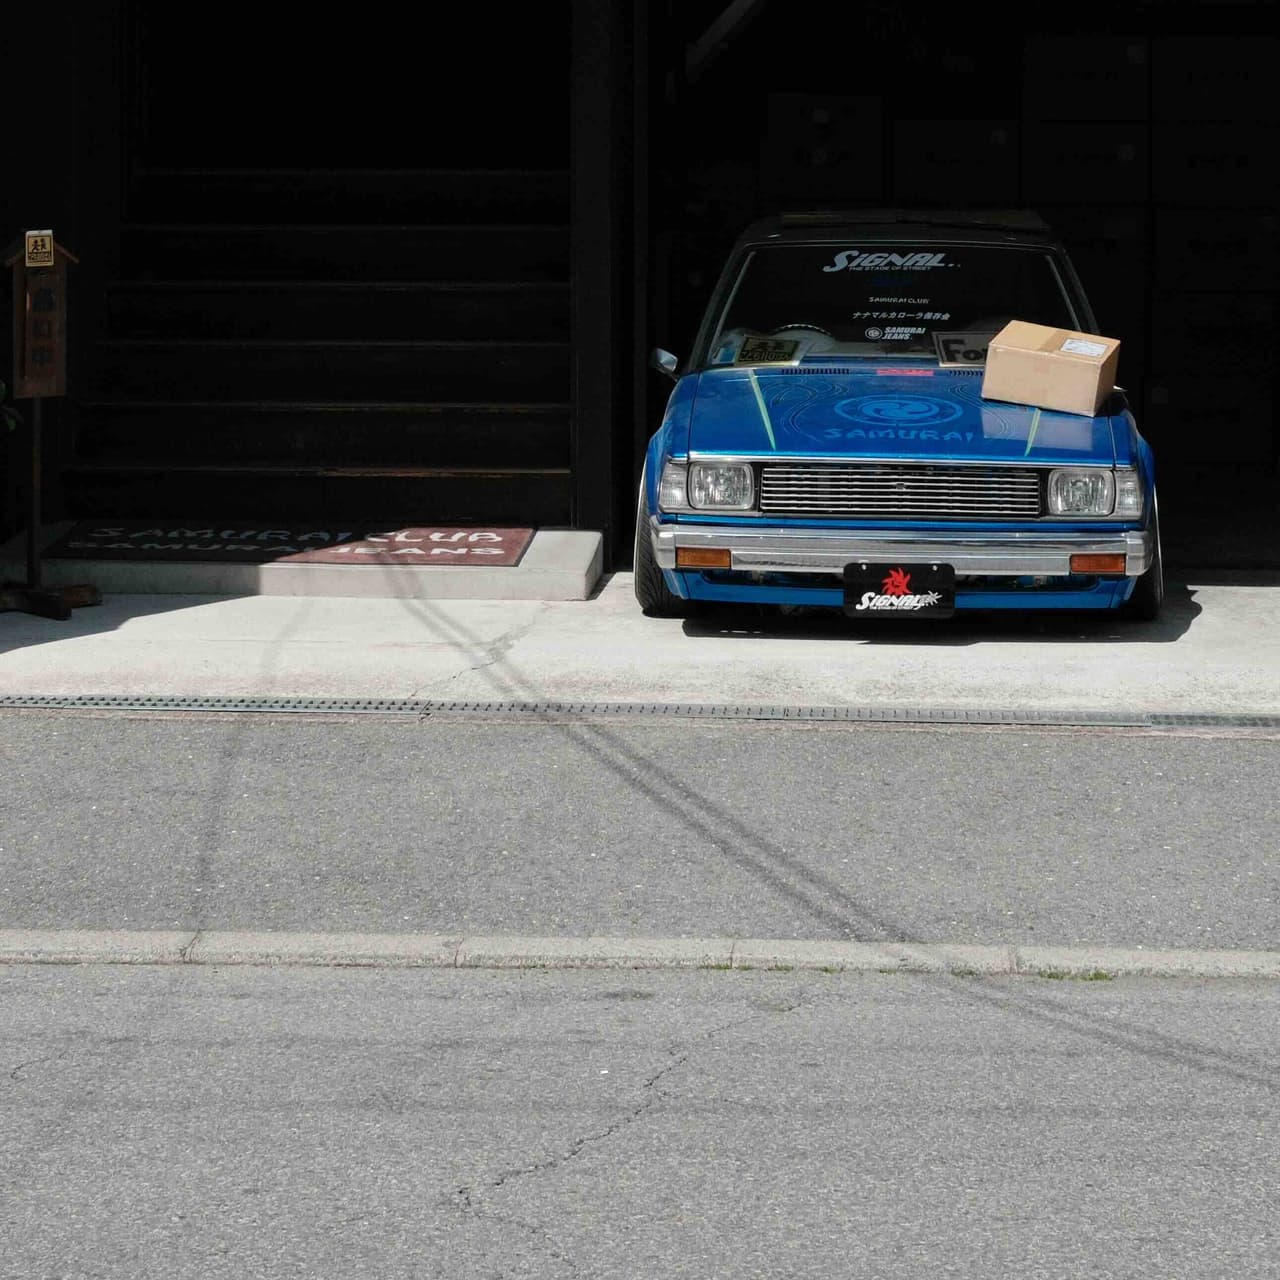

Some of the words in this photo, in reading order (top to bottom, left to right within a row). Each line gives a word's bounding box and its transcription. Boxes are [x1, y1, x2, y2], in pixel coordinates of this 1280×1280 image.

[868, 296, 907, 304] SAMURAI
[824, 428, 974, 443] SAMURAI
[87, 527, 353, 542] SAMURAI
[364, 530, 503, 542] CLUB
[67, 542, 316, 554] SAMURAI
[328, 547, 505, 555] JEANS
